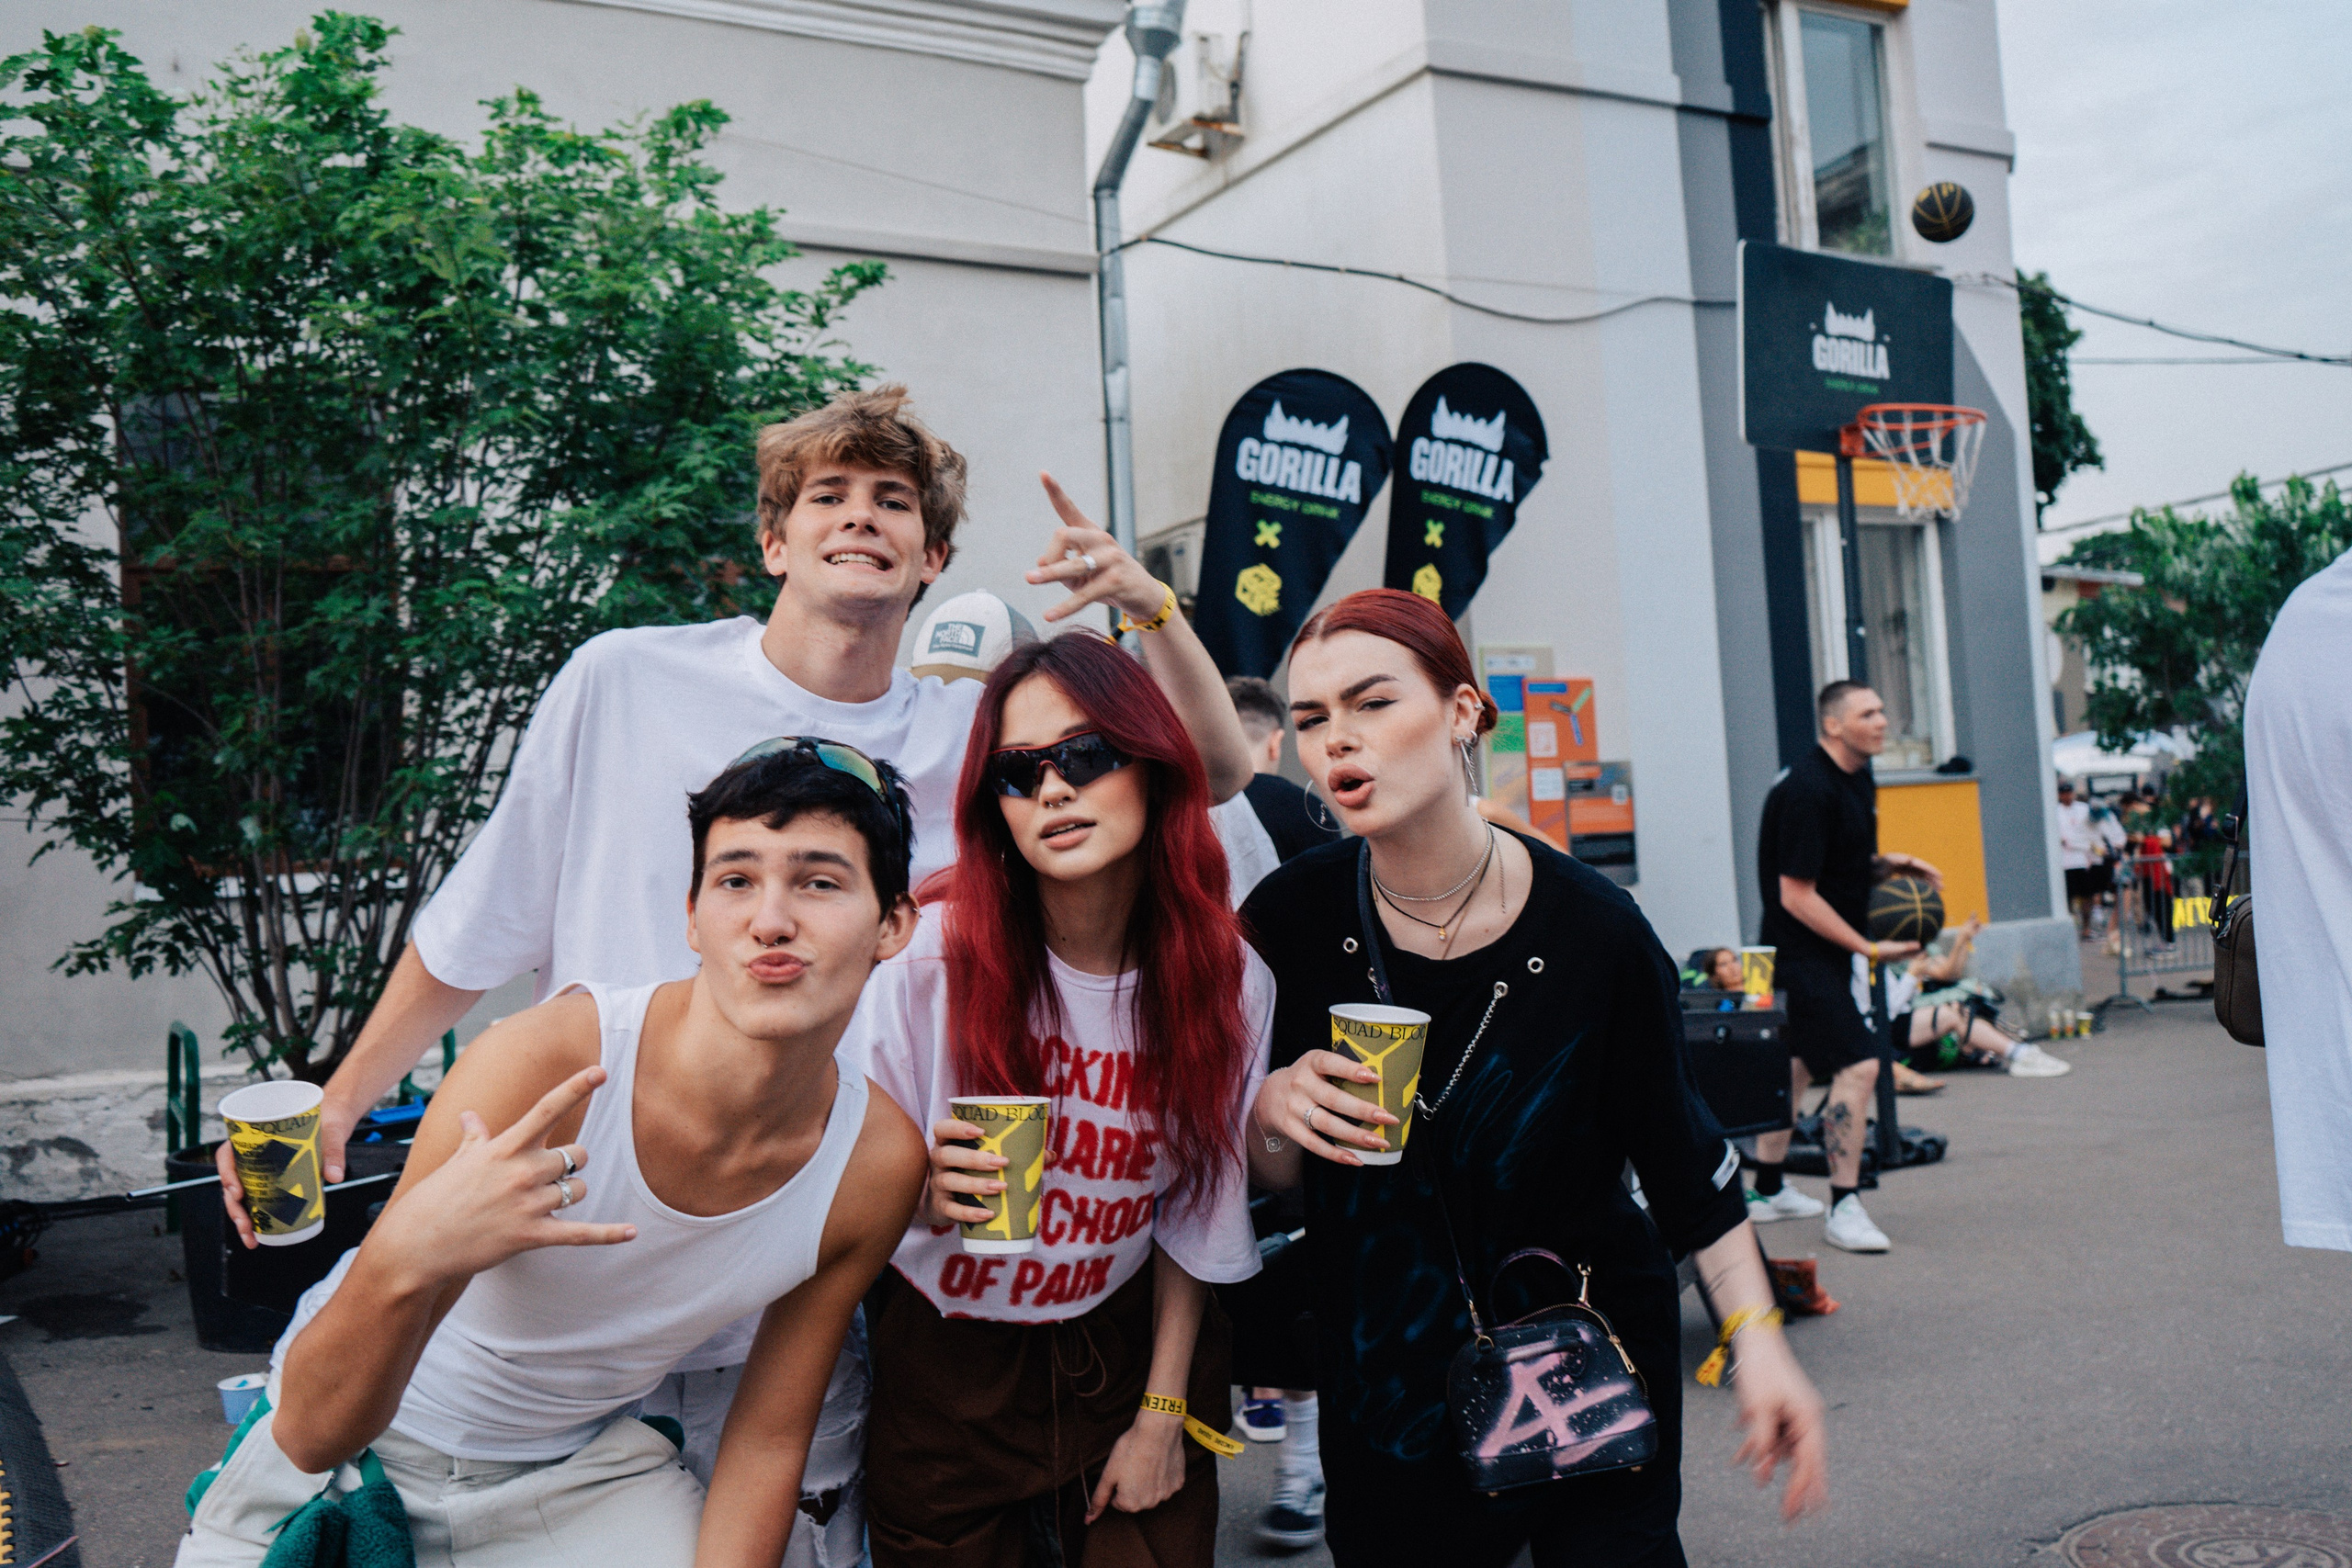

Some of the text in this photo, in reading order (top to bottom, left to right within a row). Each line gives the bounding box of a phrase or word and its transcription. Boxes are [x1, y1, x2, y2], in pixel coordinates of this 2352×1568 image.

[1812, 333, 1891, 380] GORILLA
[1236, 437, 1362, 504] GORILLA
[1409, 436, 1514, 502] GORILLA
[1044, 1115, 1161, 1181] UARE
[1036, 1188, 1156, 1247] CHOO
[939, 1253, 1115, 1307] OF PAIN
